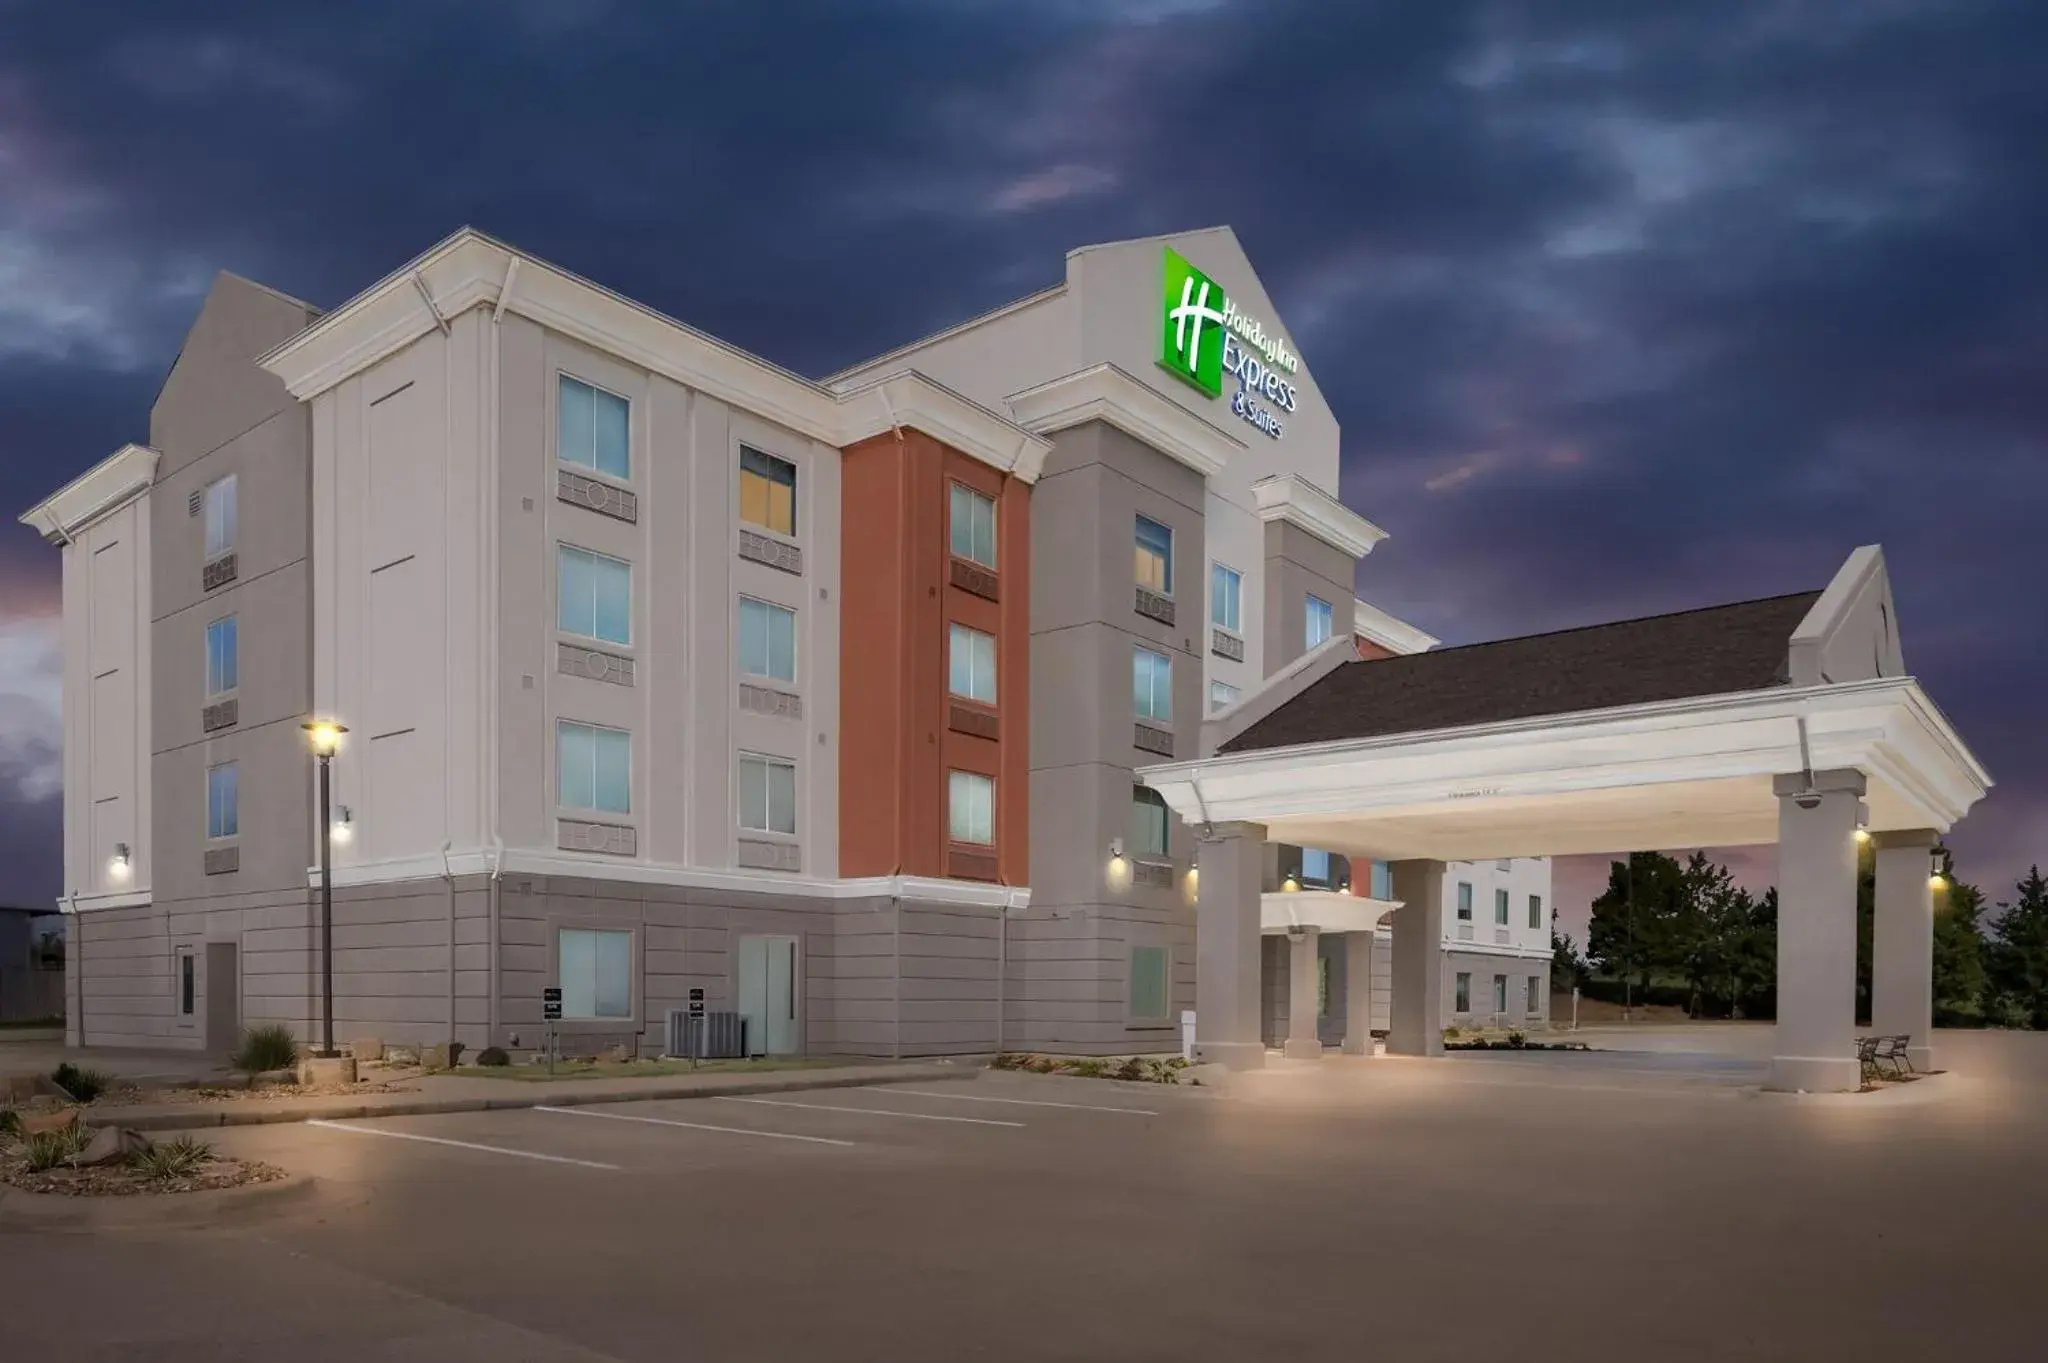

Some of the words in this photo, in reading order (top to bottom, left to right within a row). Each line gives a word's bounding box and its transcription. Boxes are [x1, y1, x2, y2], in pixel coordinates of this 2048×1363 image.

[1222, 333, 1297, 412] Express
[1223, 297, 1276, 362] Holiday
[1277, 338, 1297, 373] Inn
[1233, 391, 1246, 414] &
[1247, 400, 1283, 439] Suites
